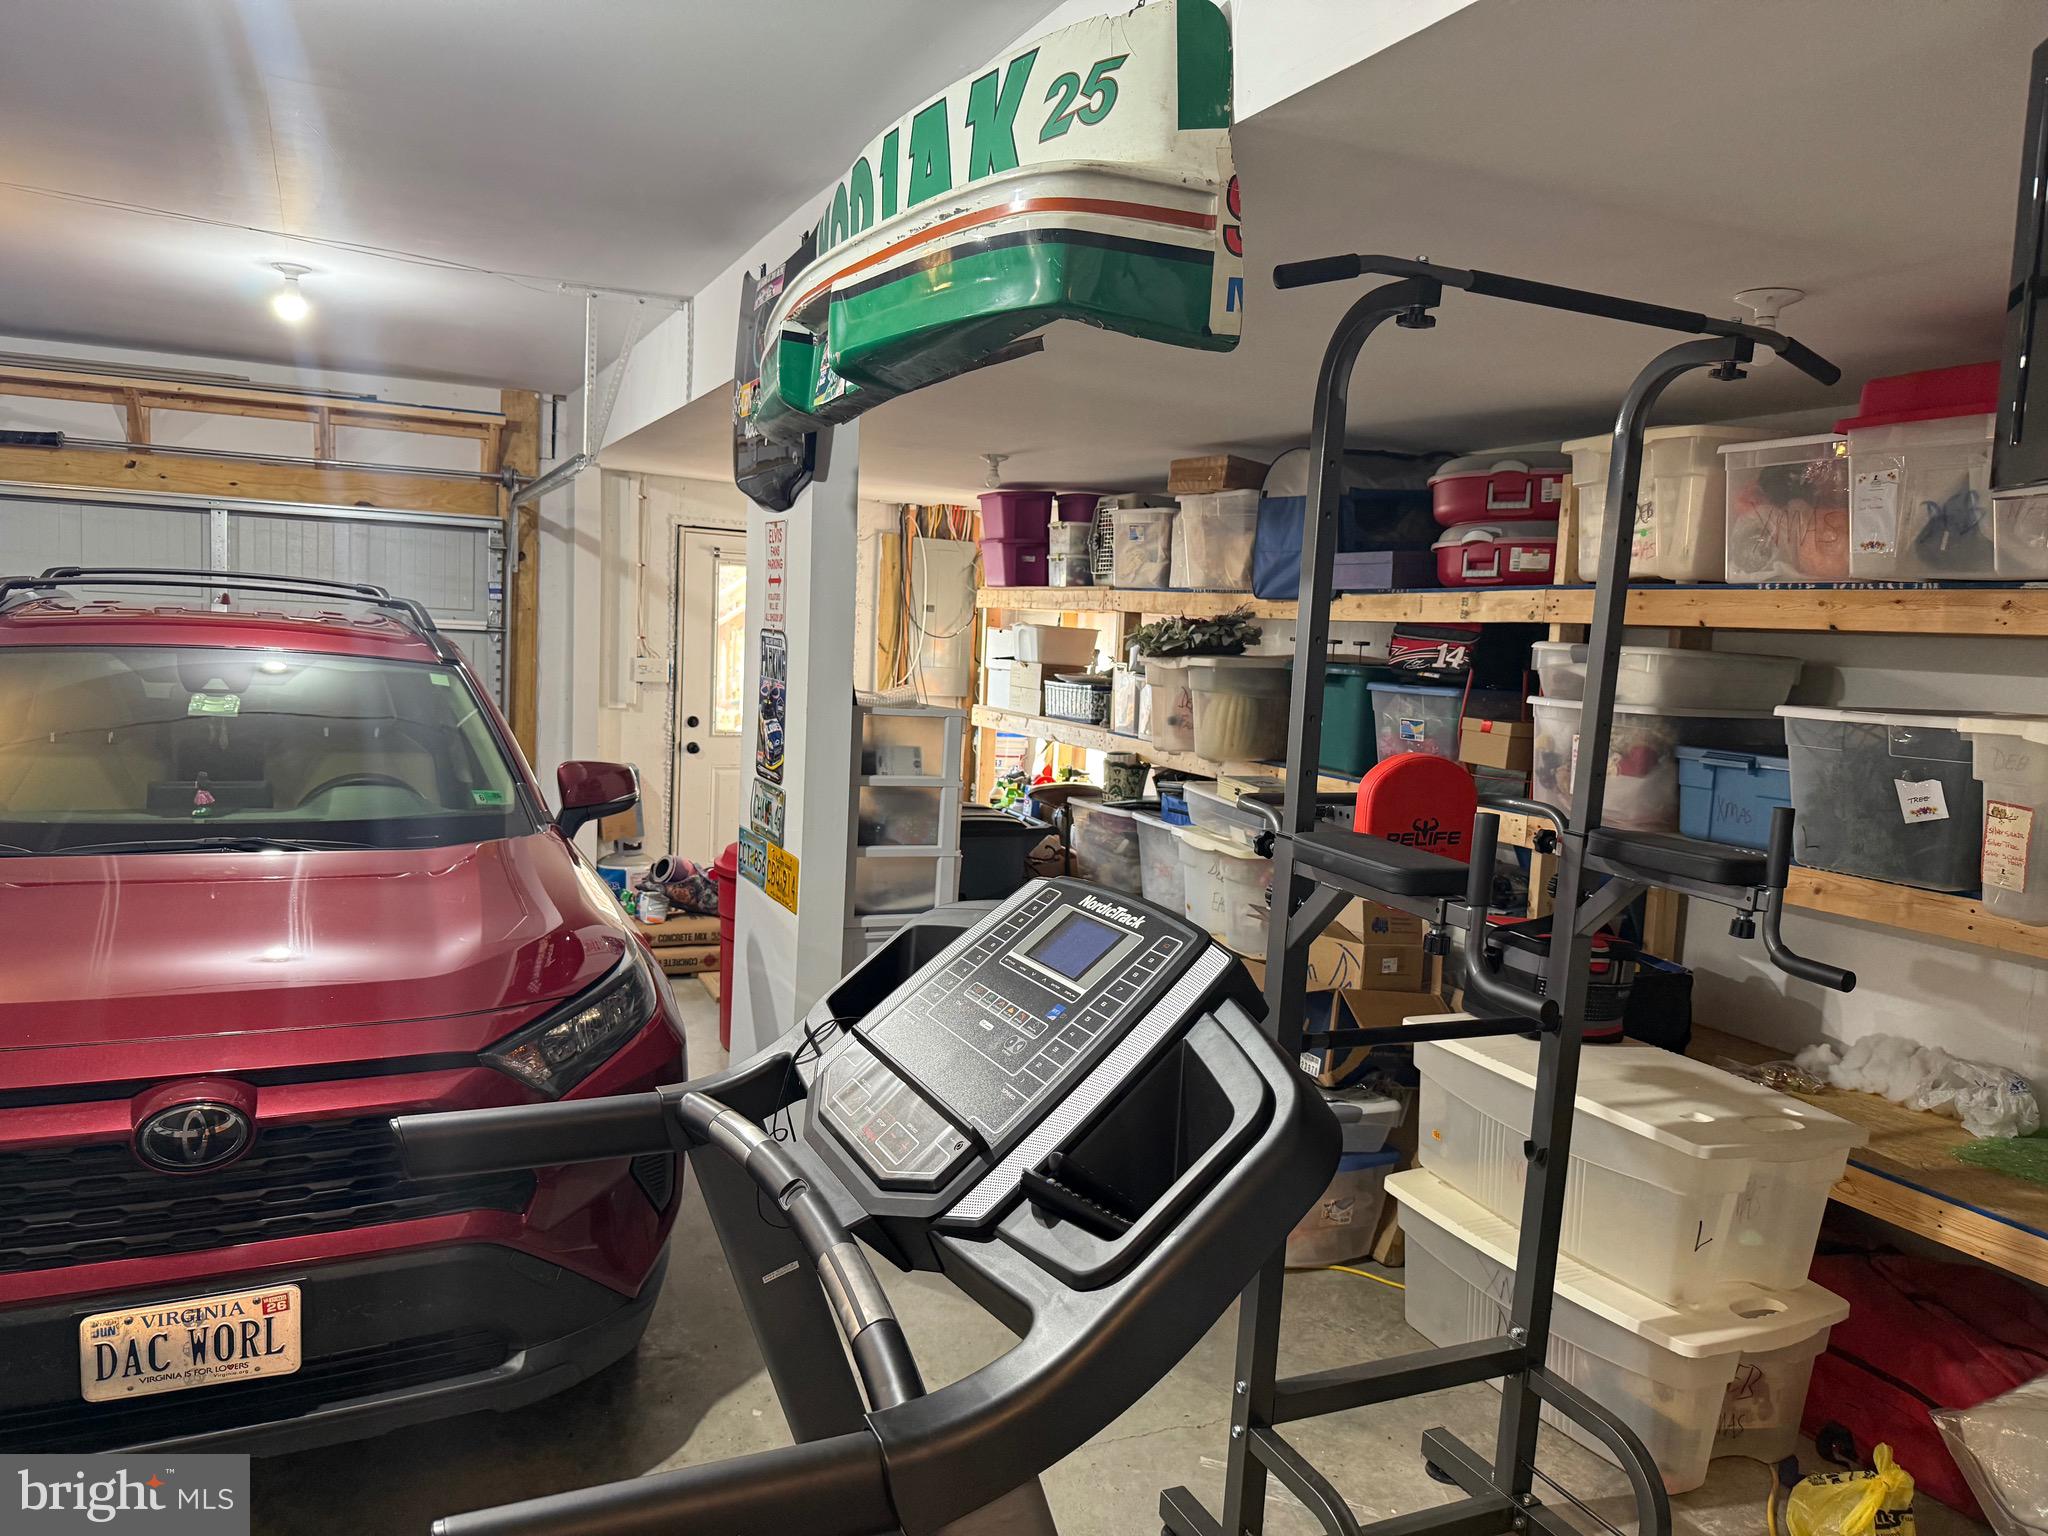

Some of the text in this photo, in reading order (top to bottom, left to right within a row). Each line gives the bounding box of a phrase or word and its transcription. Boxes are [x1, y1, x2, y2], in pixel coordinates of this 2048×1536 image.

[1039, 53, 1131, 144] 25
[768, 528, 783, 543] ELVIS
[1431, 643, 1466, 670] 14
[1078, 895, 1147, 929] NordicTrack
[658, 933, 692, 942] CONCRETE
[140, 1301, 245, 1329] VIRGINIA
[266, 1300, 287, 1312] 26
[91, 1326, 116, 1338] JUN
[94, 1316, 286, 1381] DAC WORL
[138, 1372, 182, 1384] VIRGINIA
[184, 1370, 192, 1378] IS
[194, 1367, 213, 1376] FOR
